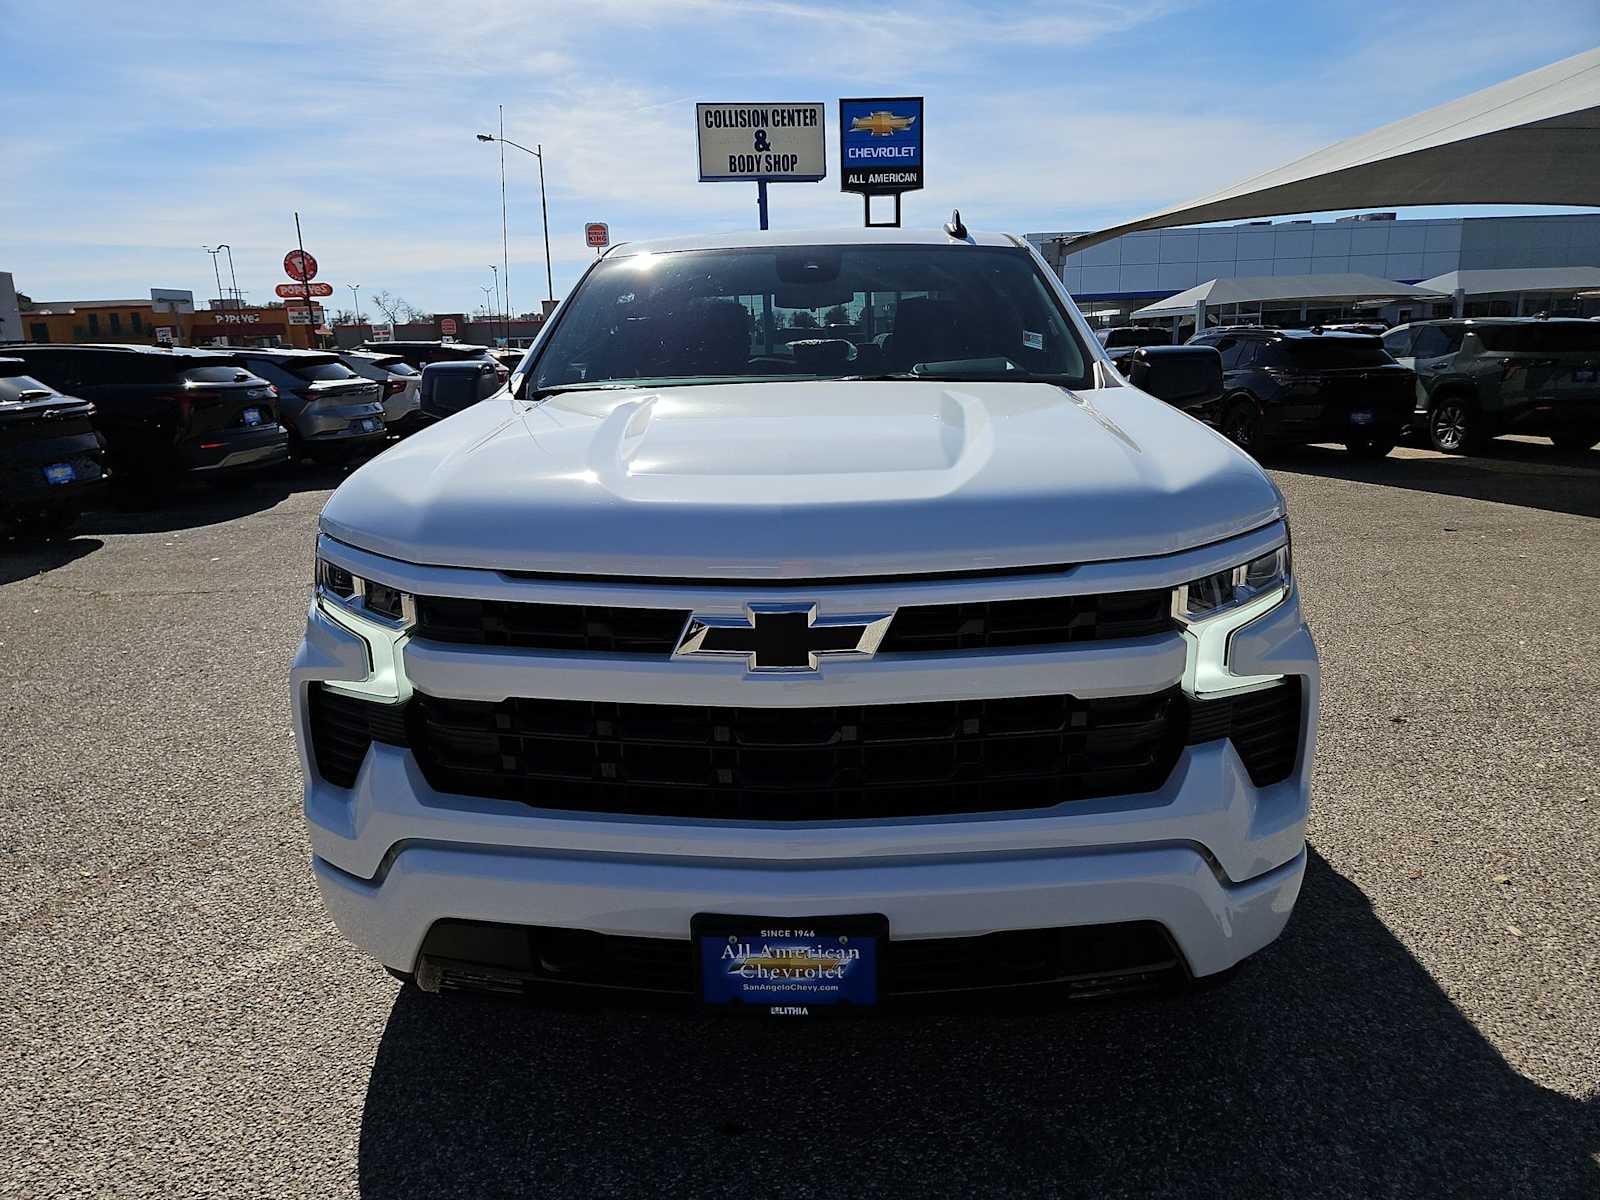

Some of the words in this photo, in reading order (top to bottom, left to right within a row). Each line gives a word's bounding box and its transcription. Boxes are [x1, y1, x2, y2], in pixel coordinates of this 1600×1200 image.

[704, 109, 769, 128] COLLISION
[772, 108, 817, 127] CENTER
[754, 129, 771, 152] &
[848, 147, 916, 158] CHEVROLET
[728, 155, 762, 173] BODY
[765, 154, 798, 172] SHOP
[848, 174, 866, 184] ALL
[868, 173, 917, 183] AMERICAN
[760, 930, 791, 938] SINCE
[794, 930, 816, 938] 1946
[721, 944, 751, 960] All
[760, 944, 860, 960] American
[740, 964, 844, 980] Chevrolet
[743, 983, 839, 993] SanAngeloChevy.com
